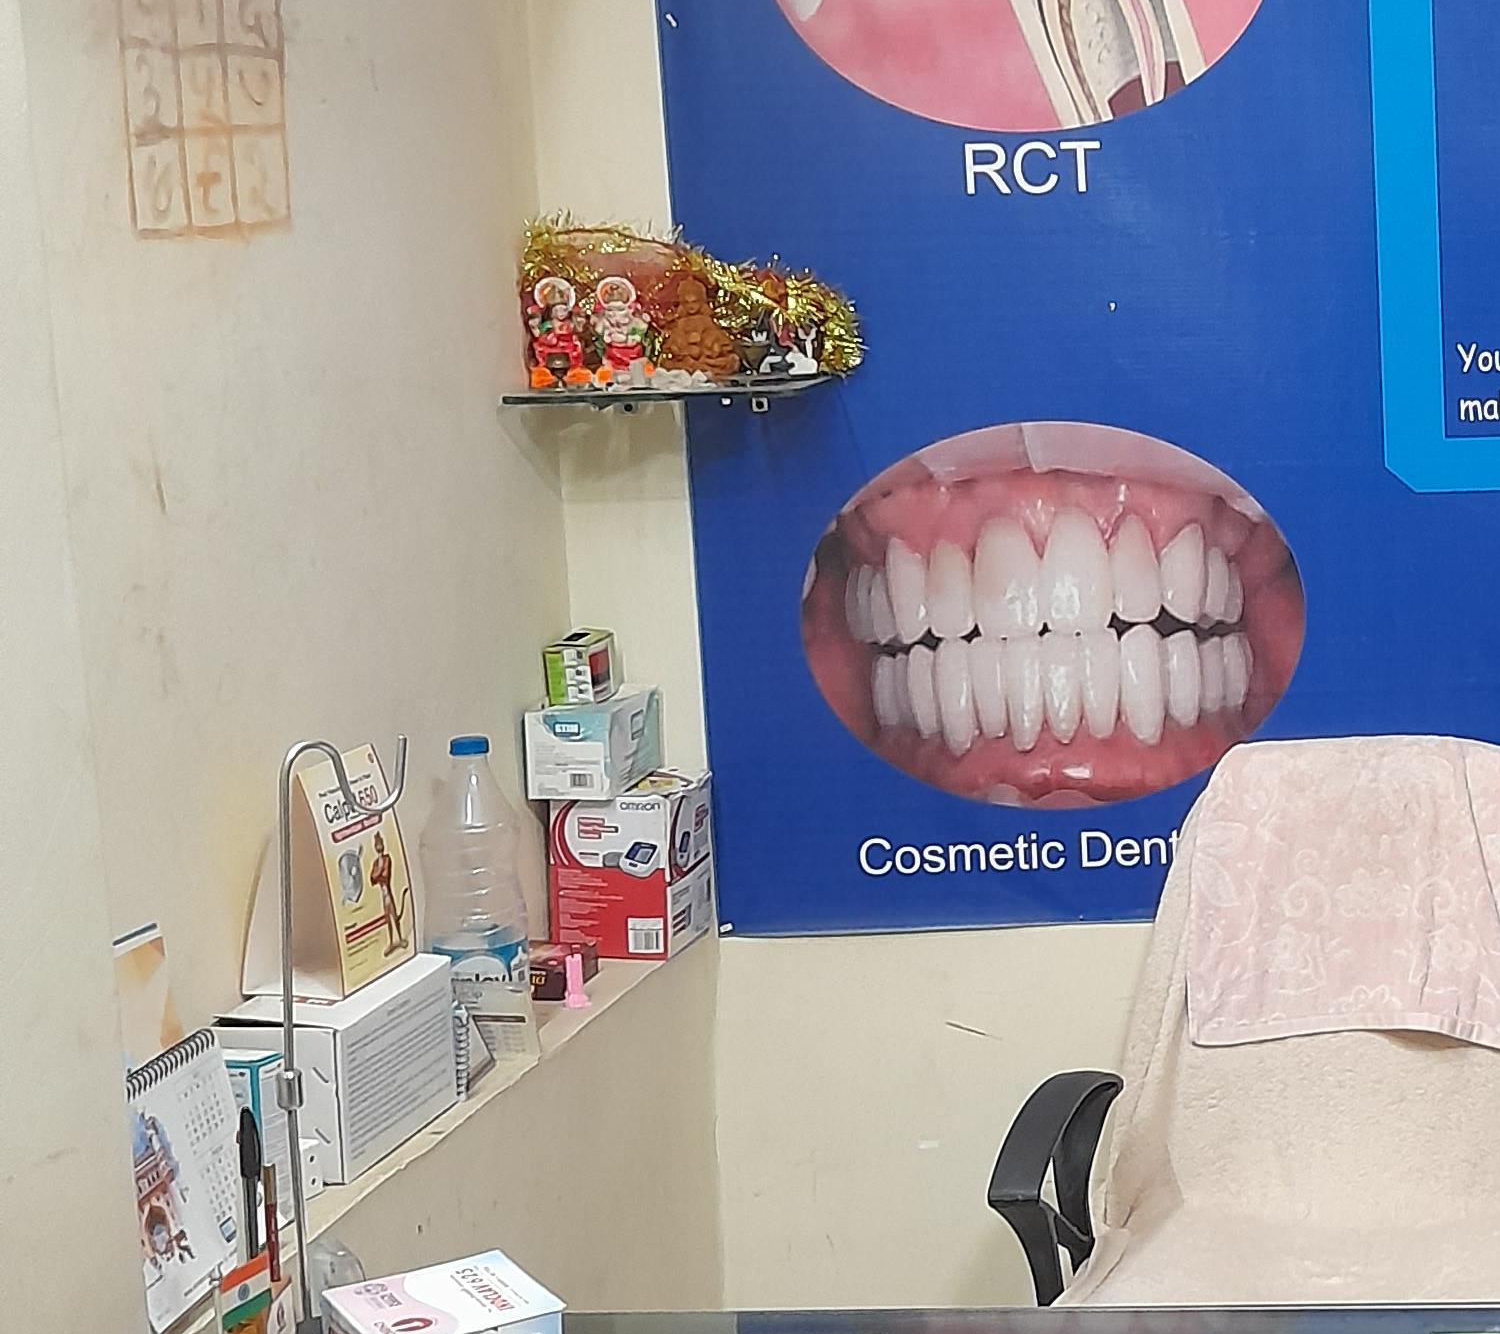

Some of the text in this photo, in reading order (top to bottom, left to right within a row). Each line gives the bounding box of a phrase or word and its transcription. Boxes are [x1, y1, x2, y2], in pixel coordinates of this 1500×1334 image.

[964, 140, 1101, 195] RCT
[323, 794, 360, 824] Calp
[859, 833, 1065, 875] Cosmetic
